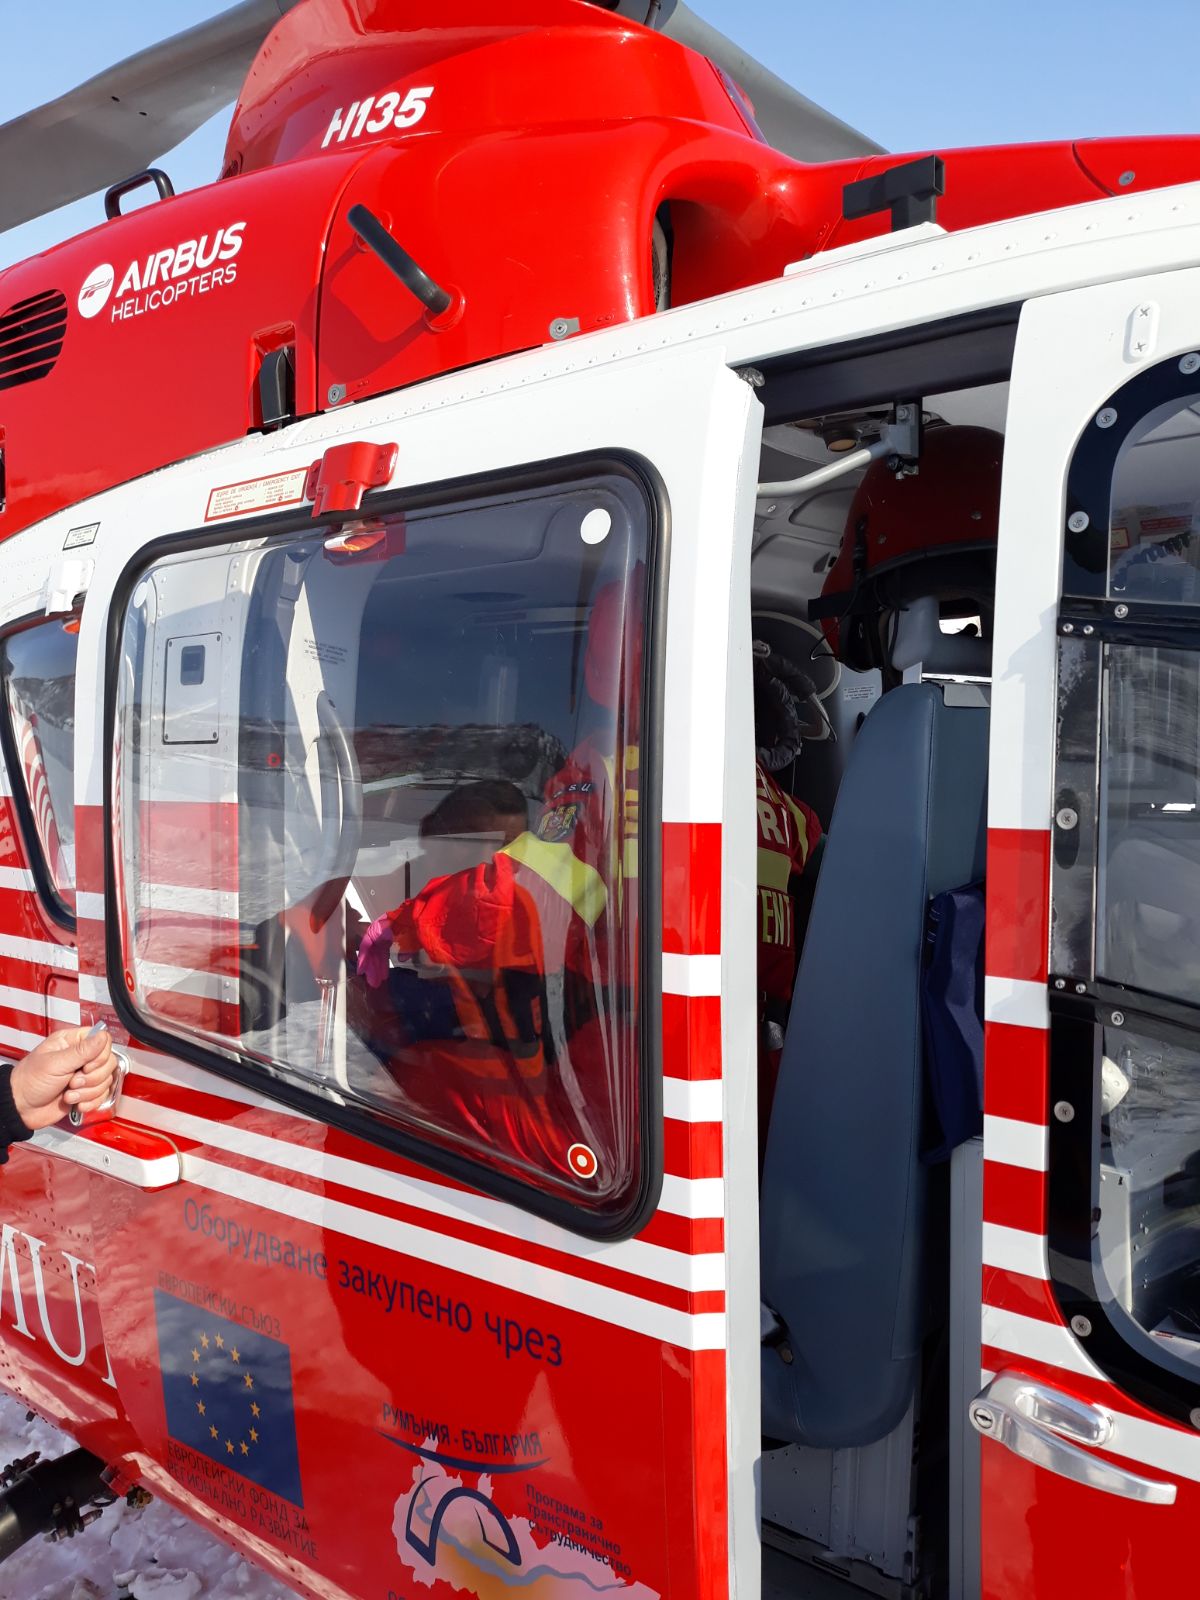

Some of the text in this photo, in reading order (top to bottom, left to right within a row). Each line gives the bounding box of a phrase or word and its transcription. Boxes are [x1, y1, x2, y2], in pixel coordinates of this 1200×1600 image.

[321, 86, 434, 149] H135
[115, 222, 247, 298] AIRBUS
[111, 263, 237, 323] HELICOPTERS
[184, 1198, 563, 1366] Оборудване закупено чрез
[382, 1402, 450, 1446] РУМЪНИЯ
[463, 1428, 543, 1457] БЪЛГАРИЯ
[526, 1484, 604, 1531] Програма за
[527, 1502, 621, 1556] трансгранично
[528, 1518, 632, 1576] сътрудничество
